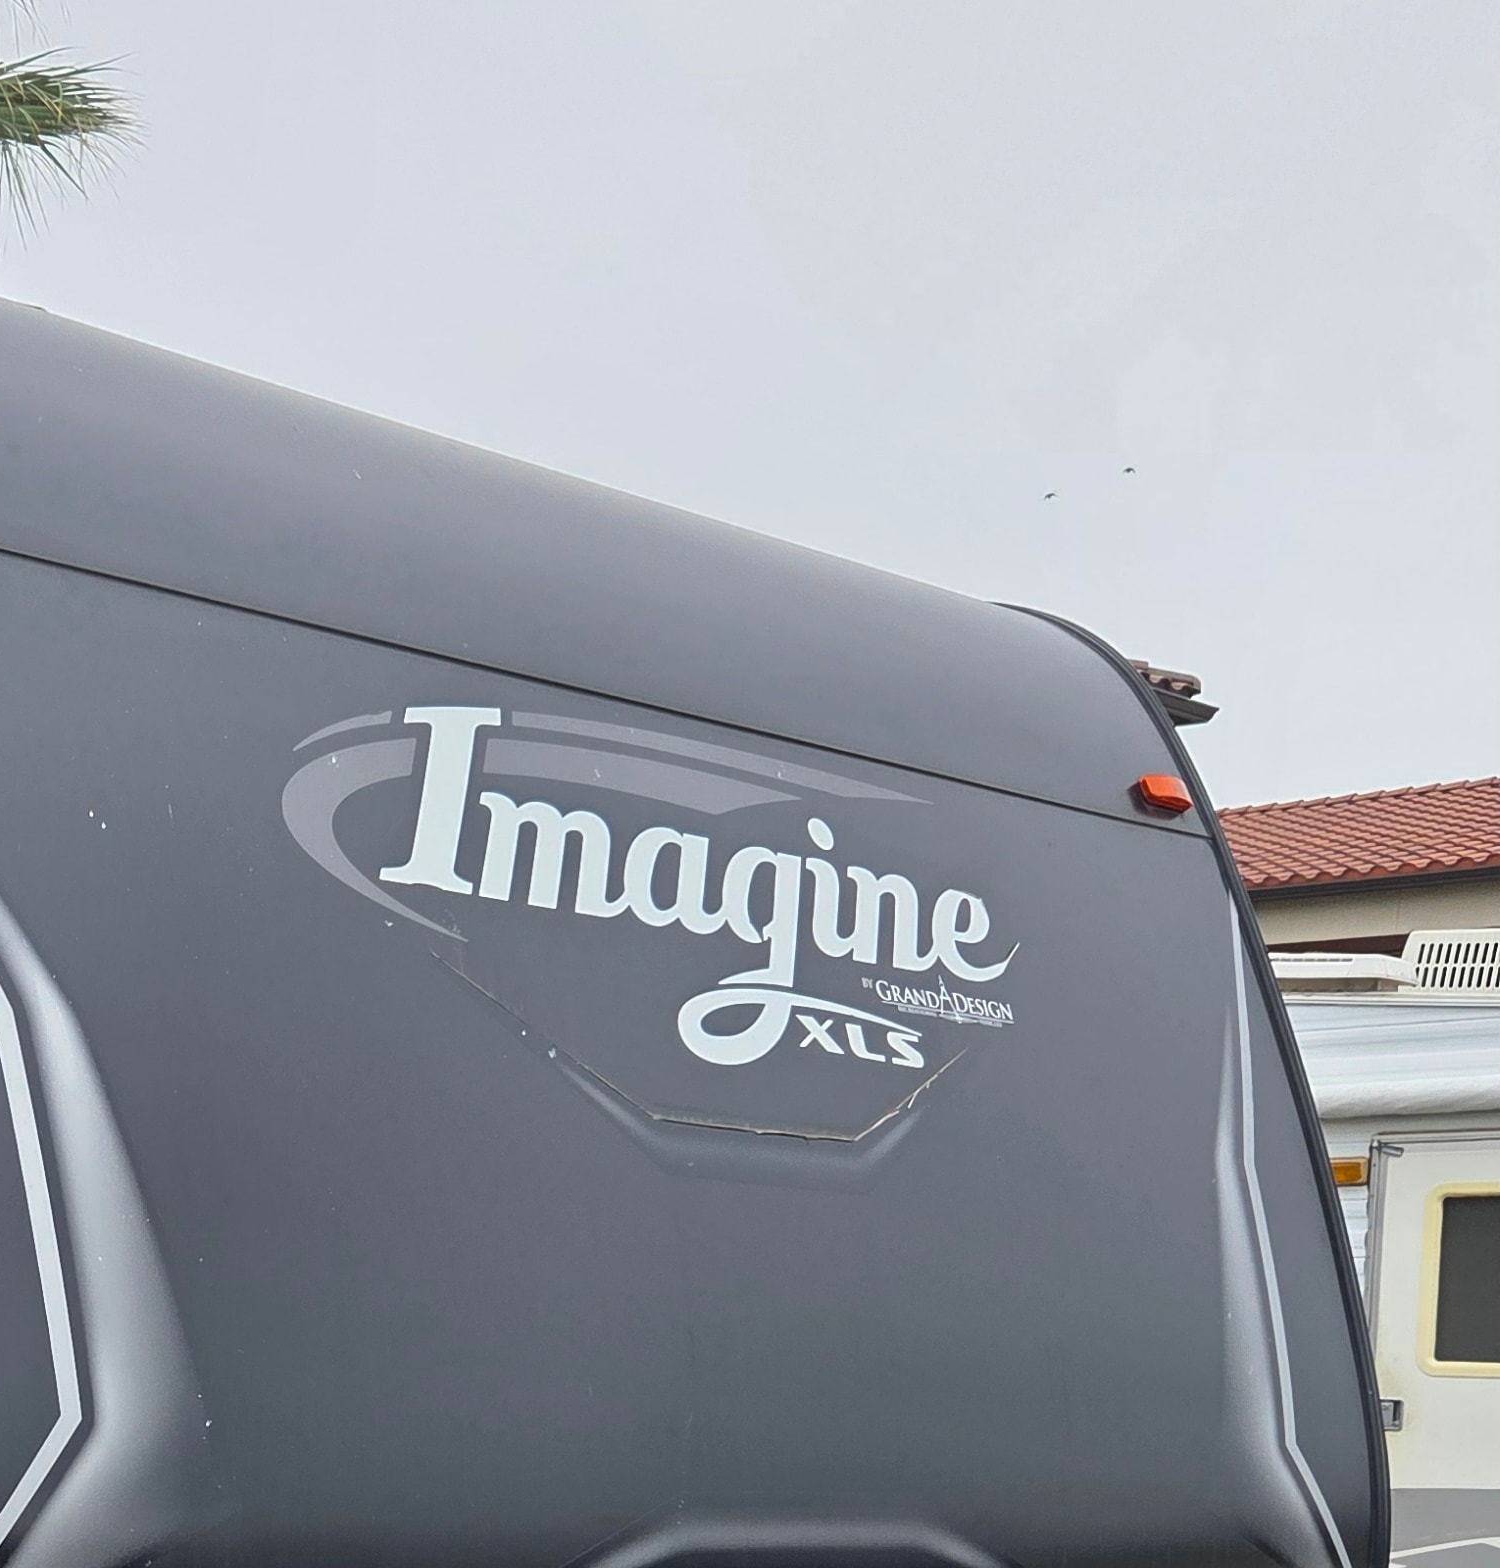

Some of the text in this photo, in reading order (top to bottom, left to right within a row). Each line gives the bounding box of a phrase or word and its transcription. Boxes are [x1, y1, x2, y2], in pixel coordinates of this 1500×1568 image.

[379, 706, 1020, 1065] Imagine
[861, 977, 873, 989] BY
[875, 980, 940, 1009] GRAND
[951, 992, 1014, 1020] DESIGN
[795, 1013, 925, 1069] XLS
